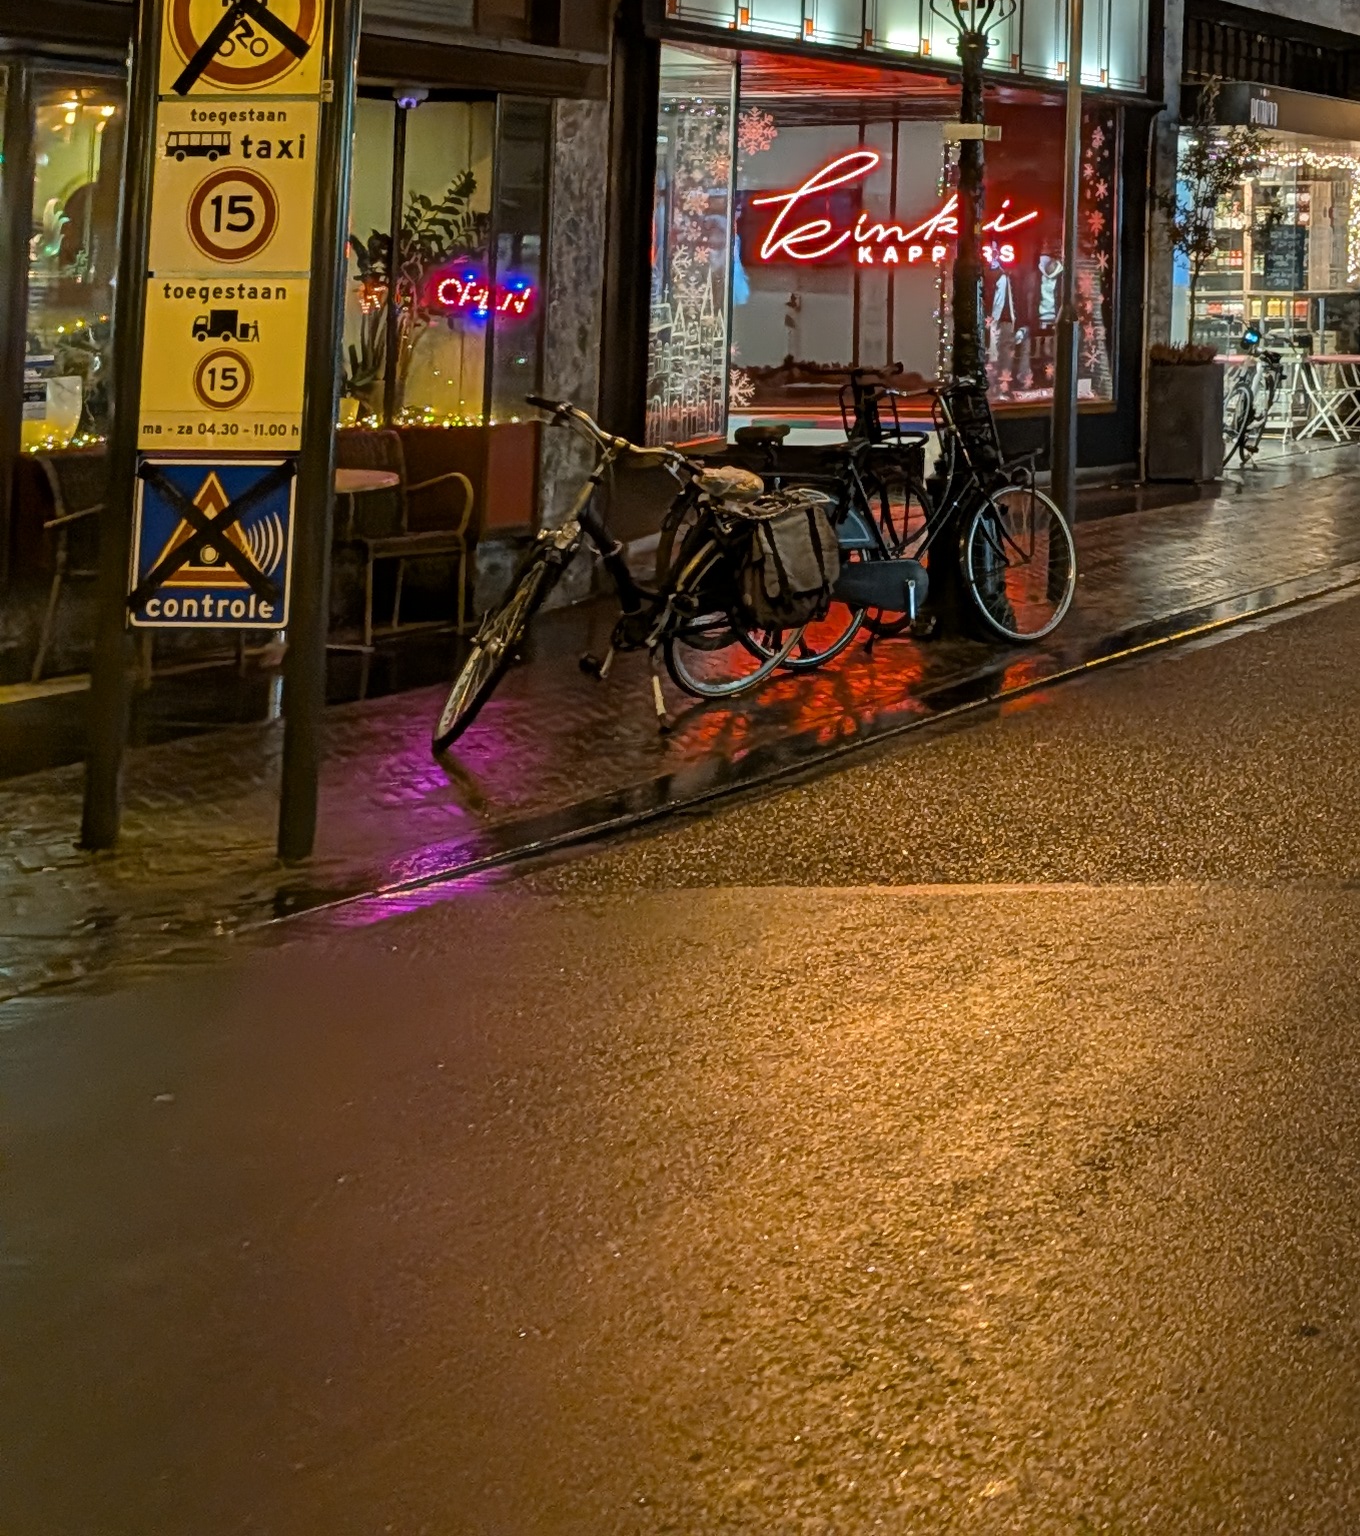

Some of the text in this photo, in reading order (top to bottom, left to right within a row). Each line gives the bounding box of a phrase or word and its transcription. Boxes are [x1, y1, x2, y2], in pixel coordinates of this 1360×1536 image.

[190, 108, 287, 126] toegestaan
[240, 133, 306, 159] taxi
[210, 195, 255, 233] 15
[858, 245, 1015, 264] KAPPRS
[163, 283, 287, 304] toegestaan
[207, 367, 238, 391] 15
[142, 425, 162, 434] ma
[176, 425, 193, 434] za
[197, 423, 239, 436] 04.30
[253, 423, 287, 436] 11.00
[291, 425, 299, 436] h
[145, 593, 275, 619] controle
